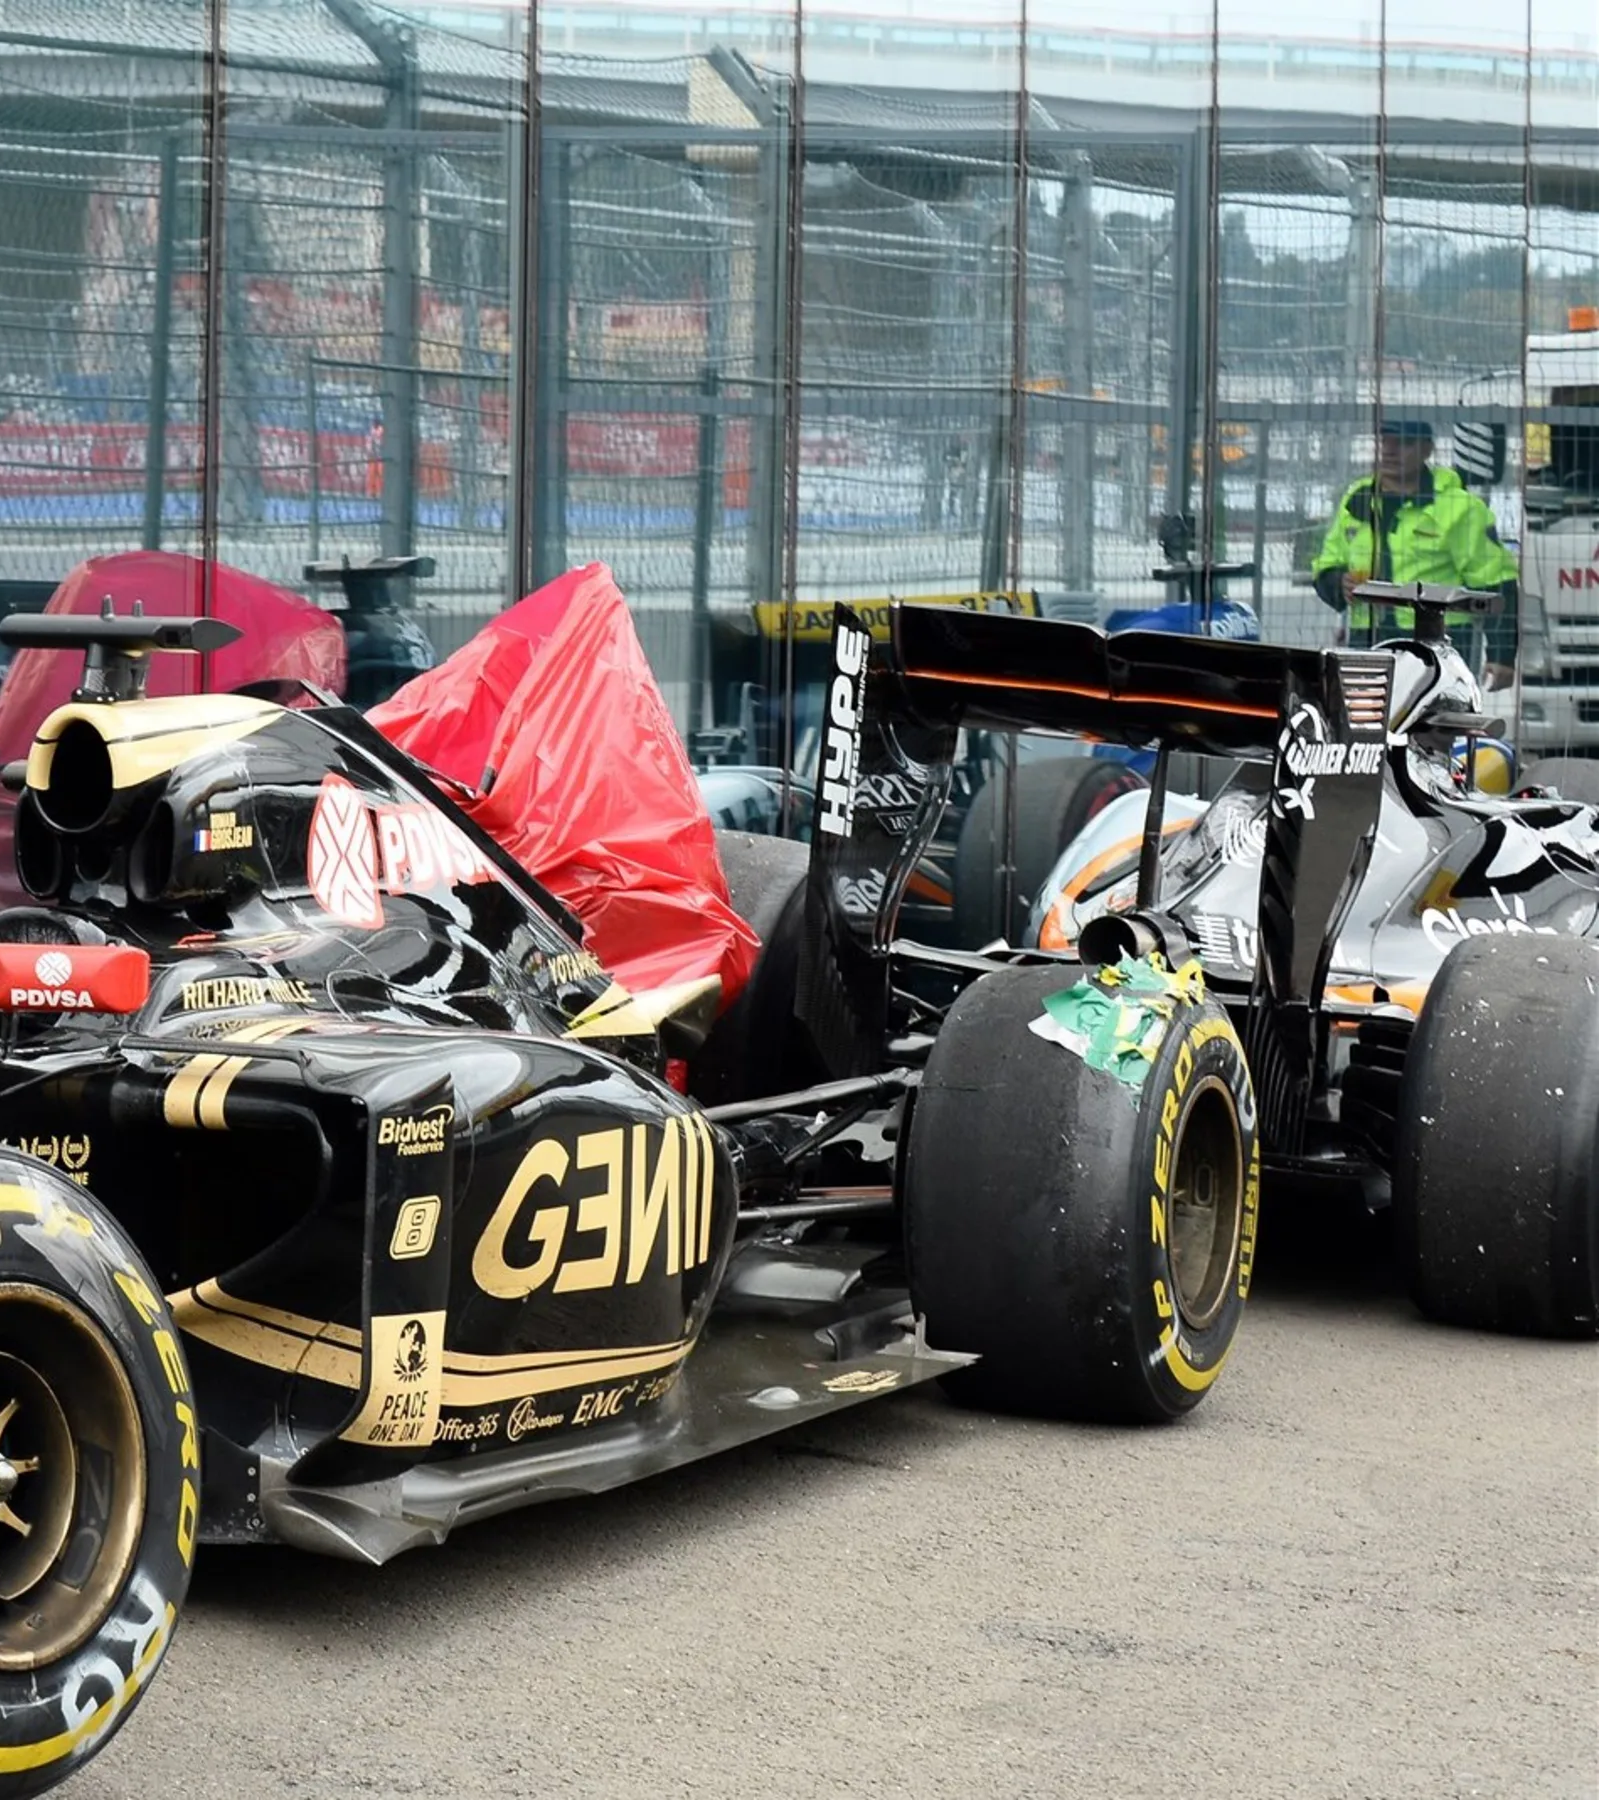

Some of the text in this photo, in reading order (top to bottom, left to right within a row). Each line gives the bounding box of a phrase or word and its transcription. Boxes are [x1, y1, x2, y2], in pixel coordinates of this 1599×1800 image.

[820, 625, 864, 835] HYPE
[1345, 742, 1385, 775] STATE
[10, 988, 95, 1008] PDVSA
[181, 976, 266, 1010] RICHARD
[378, 1114, 445, 1144] Bidvest
[397, 1139, 445, 1156] Foodservice
[1151, 1040, 1193, 1318] P ZERO
[390, 1195, 442, 1260] 8
[379, 1391, 428, 1421] PEACE
[368, 1421, 425, 1442] ONE DAY
[433, 1412, 500, 1442] Office 365
